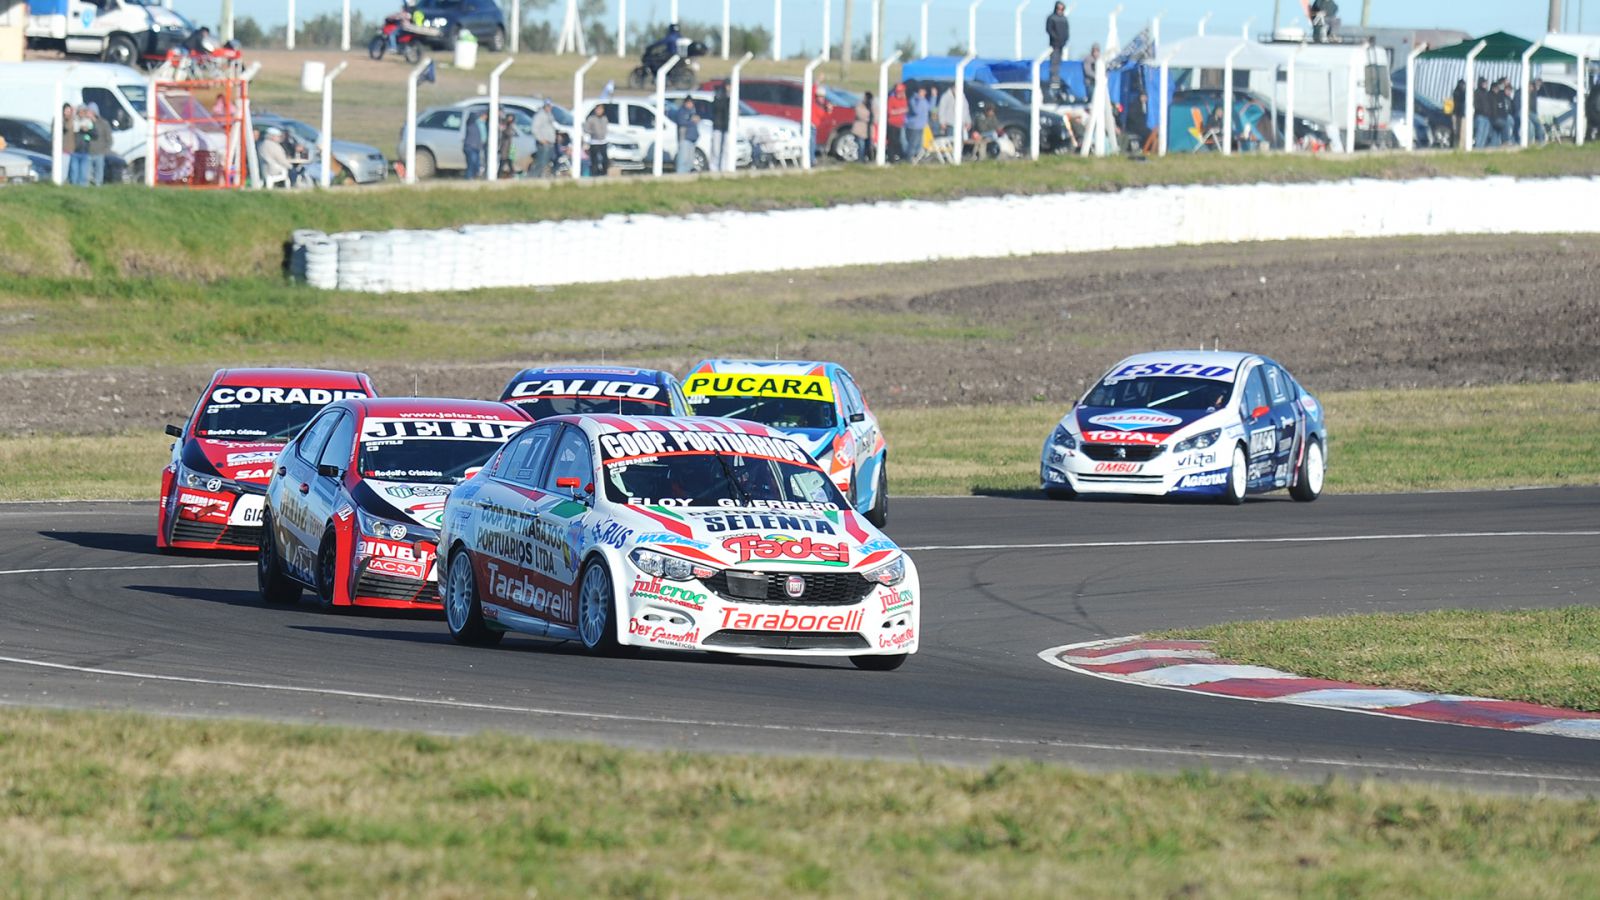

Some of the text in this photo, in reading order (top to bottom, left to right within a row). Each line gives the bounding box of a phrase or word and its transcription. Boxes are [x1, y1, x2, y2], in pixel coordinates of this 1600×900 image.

[1113, 363, 1233, 377] ESCO
[511, 379, 660, 399] CALICO
[691, 377, 824, 396] PUCARA
[1096, 415, 1175, 424] PALADINI
[1087, 430, 1160, 443] TOTAL
[600, 431, 674, 459] COOP.
[671, 431, 809, 464] PORTUARIOS
[606, 456, 658, 469] WERNER
[1094, 463, 1138, 473] OMBU
[627, 497, 693, 507] ELOY
[704, 514, 836, 535] SELENIA
[476, 525, 533, 565] PORTUARIOS
[722, 532, 849, 563] Fadel
[487, 562, 573, 622] Taraborelli
[721, 607, 865, 631] Taraborelli
